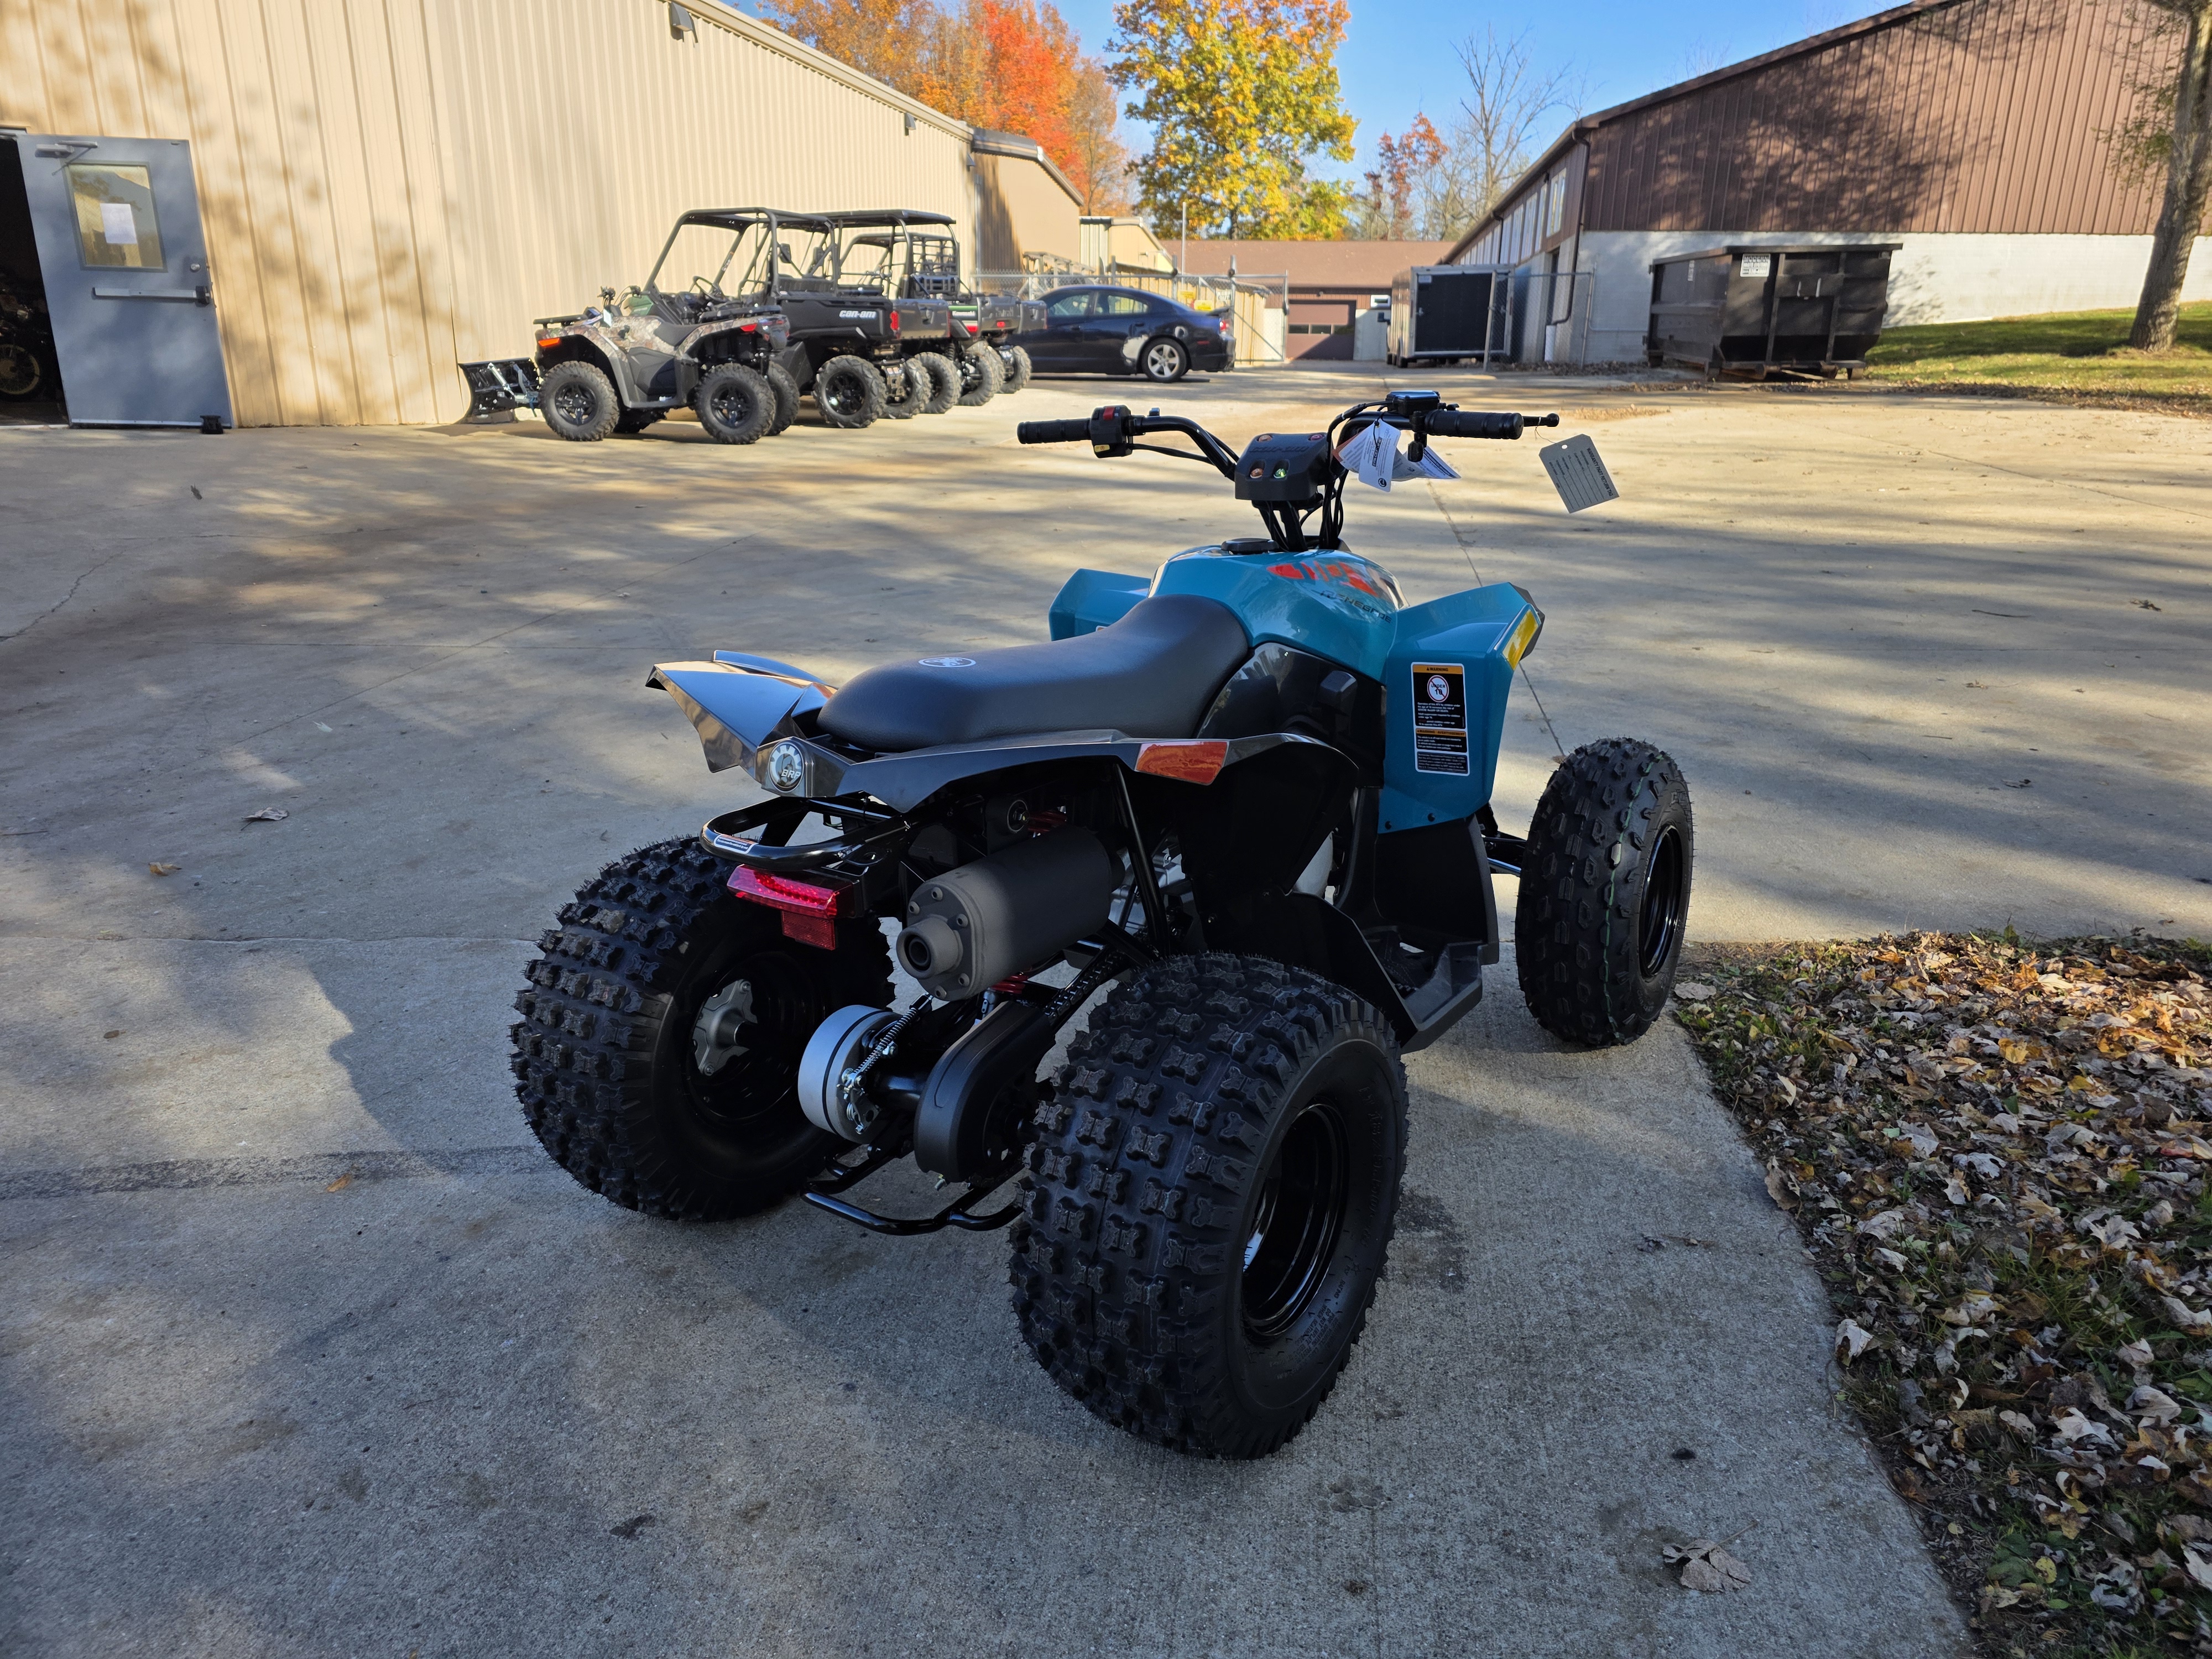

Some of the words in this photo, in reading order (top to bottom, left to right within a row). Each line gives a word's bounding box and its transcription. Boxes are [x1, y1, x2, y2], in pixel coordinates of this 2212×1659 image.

[839, 310, 877, 319] can-am
[1587, 447, 1599, 467] WARRANTY
[1595, 466, 1604, 476] PART
[1600, 475, 1610, 490] RETURN
[781, 769, 801, 779] BRP
[1333, 1279, 1345, 1299] RATING
[1317, 1304, 1327, 1318] WHEN
[1324, 1308, 1331, 1316] DO
[1318, 1316, 1326, 1328] NOT
